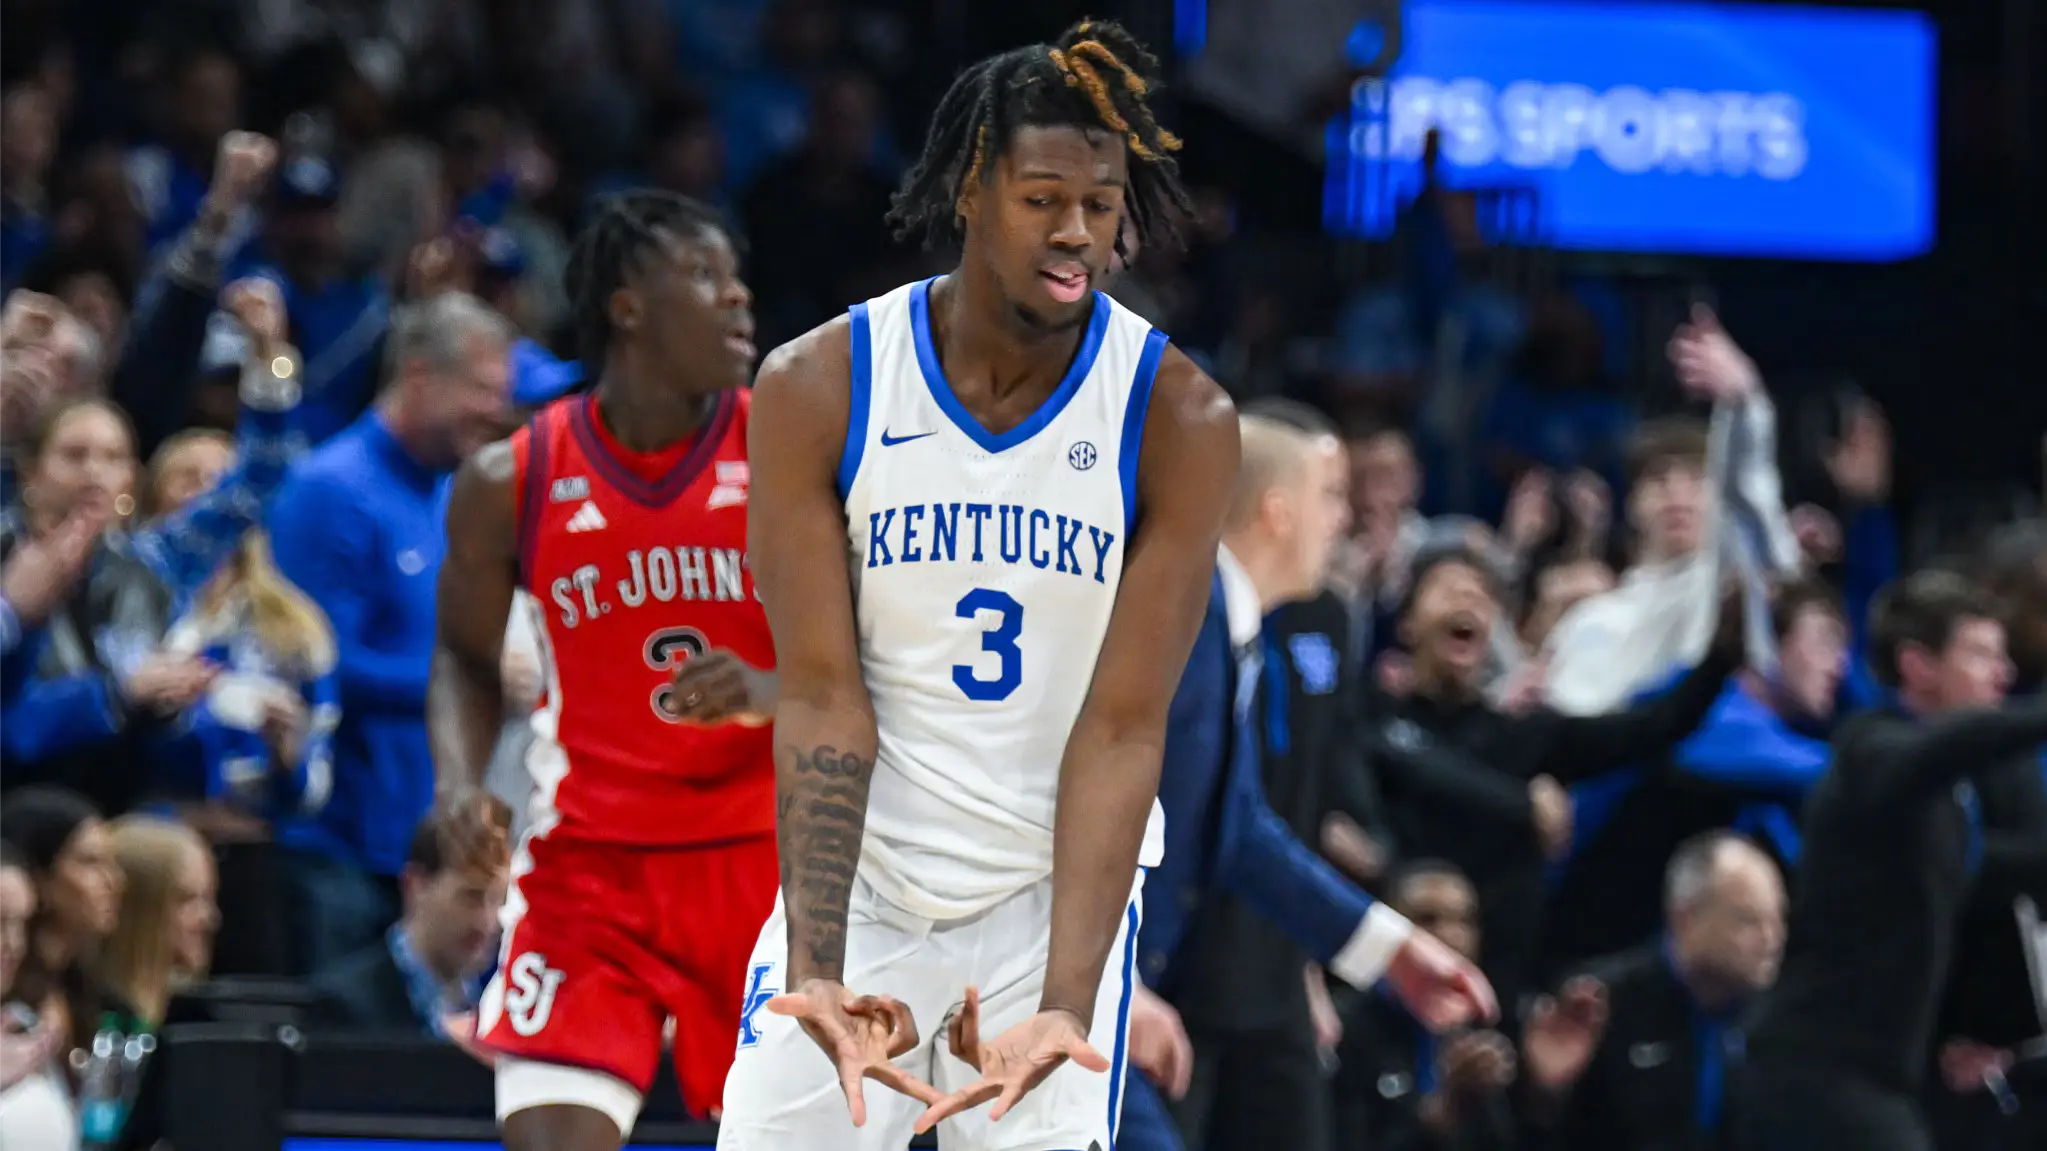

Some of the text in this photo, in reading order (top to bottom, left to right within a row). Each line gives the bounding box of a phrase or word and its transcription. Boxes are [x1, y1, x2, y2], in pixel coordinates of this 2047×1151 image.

[1498, 80, 1808, 180] SPORTS
[1070, 442, 1096, 470] SEC
[867, 503, 1114, 584] KENTUCKY
[551, 564, 612, 629] ST.
[952, 587, 1024, 701] 3
